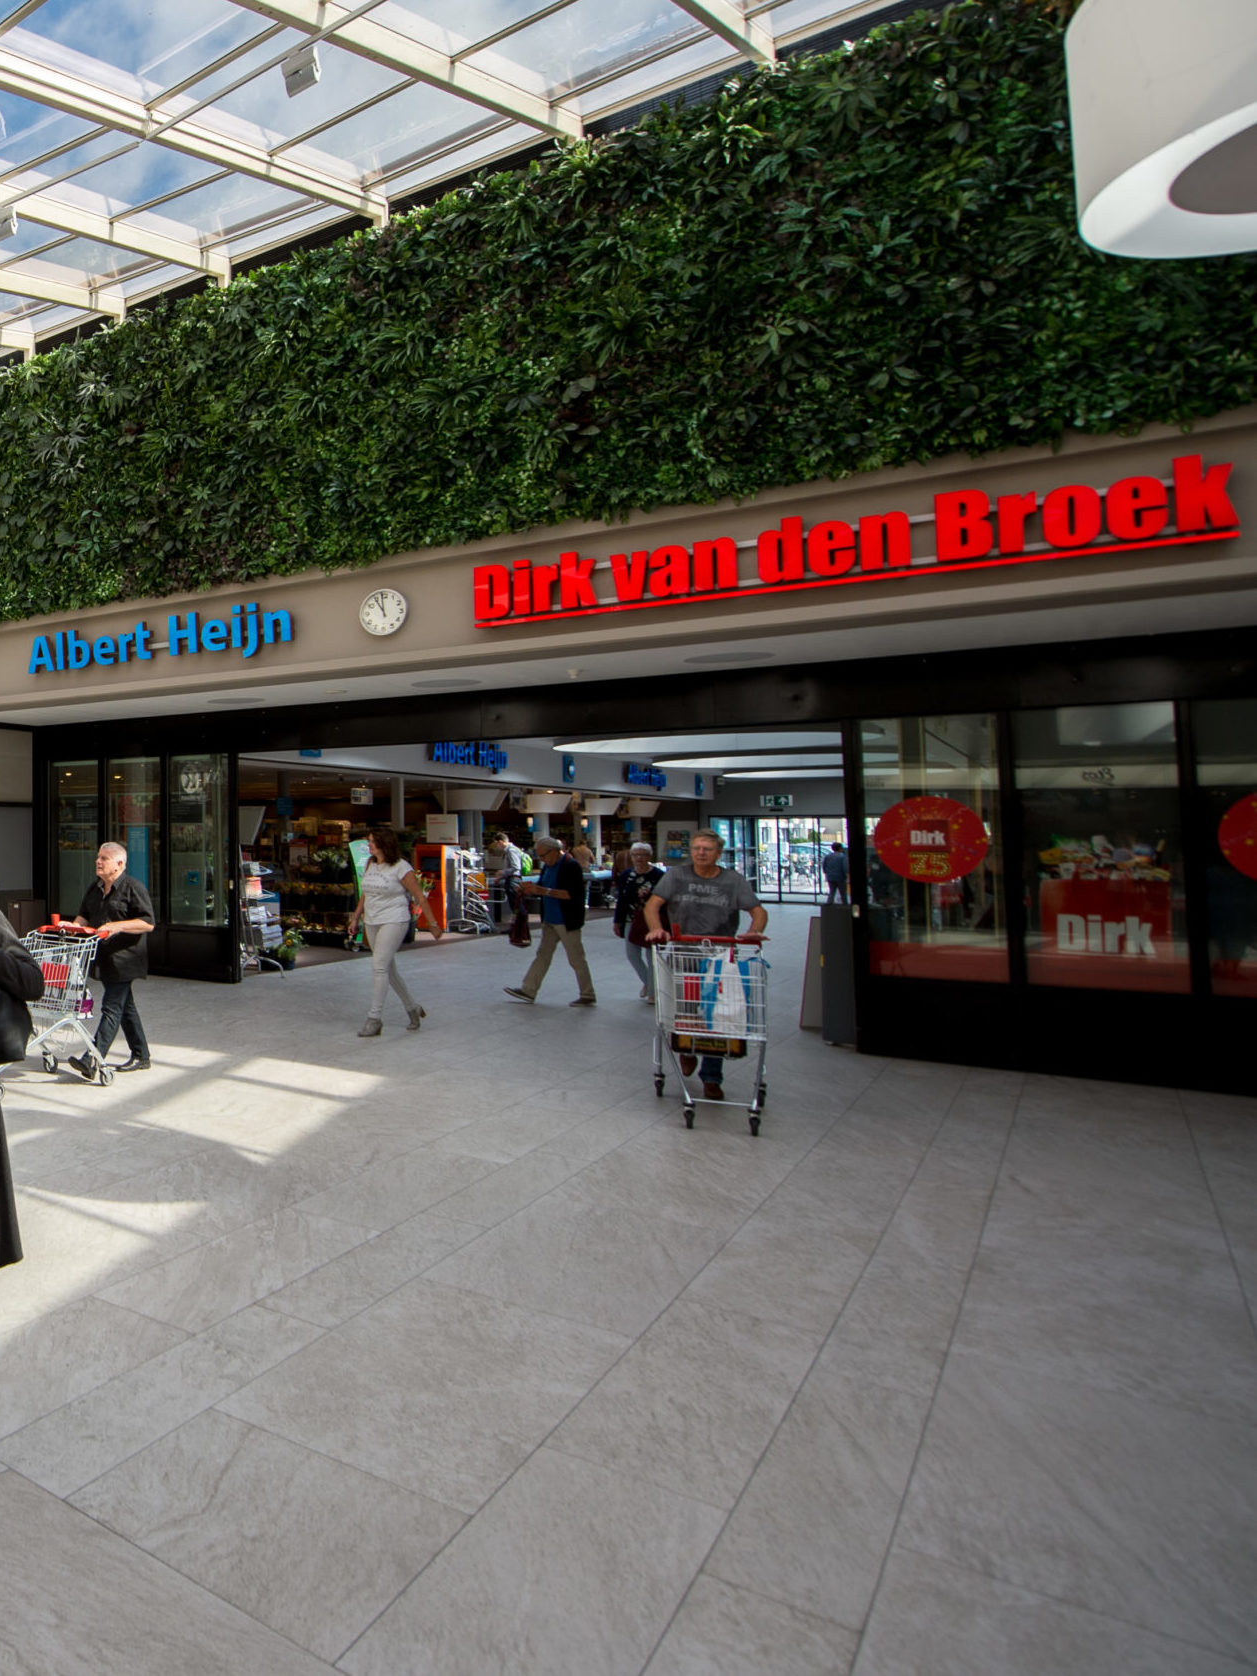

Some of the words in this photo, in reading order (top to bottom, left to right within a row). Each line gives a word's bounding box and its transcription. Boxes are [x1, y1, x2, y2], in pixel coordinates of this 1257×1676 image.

[474, 551, 598, 621] Dirk
[610, 537, 738, 602] van
[757, 515, 911, 585] den
[934, 454, 1240, 562] Broek
[28, 621, 154, 674] Albert
[168, 602, 293, 659] Heijn
[432, 742, 476, 766] Albert
[479, 741, 509, 774] Heijn
[910, 830, 946, 846] Dirk
[688, 883, 719, 895] PME
[1057, 914, 1156, 956] Dirk
